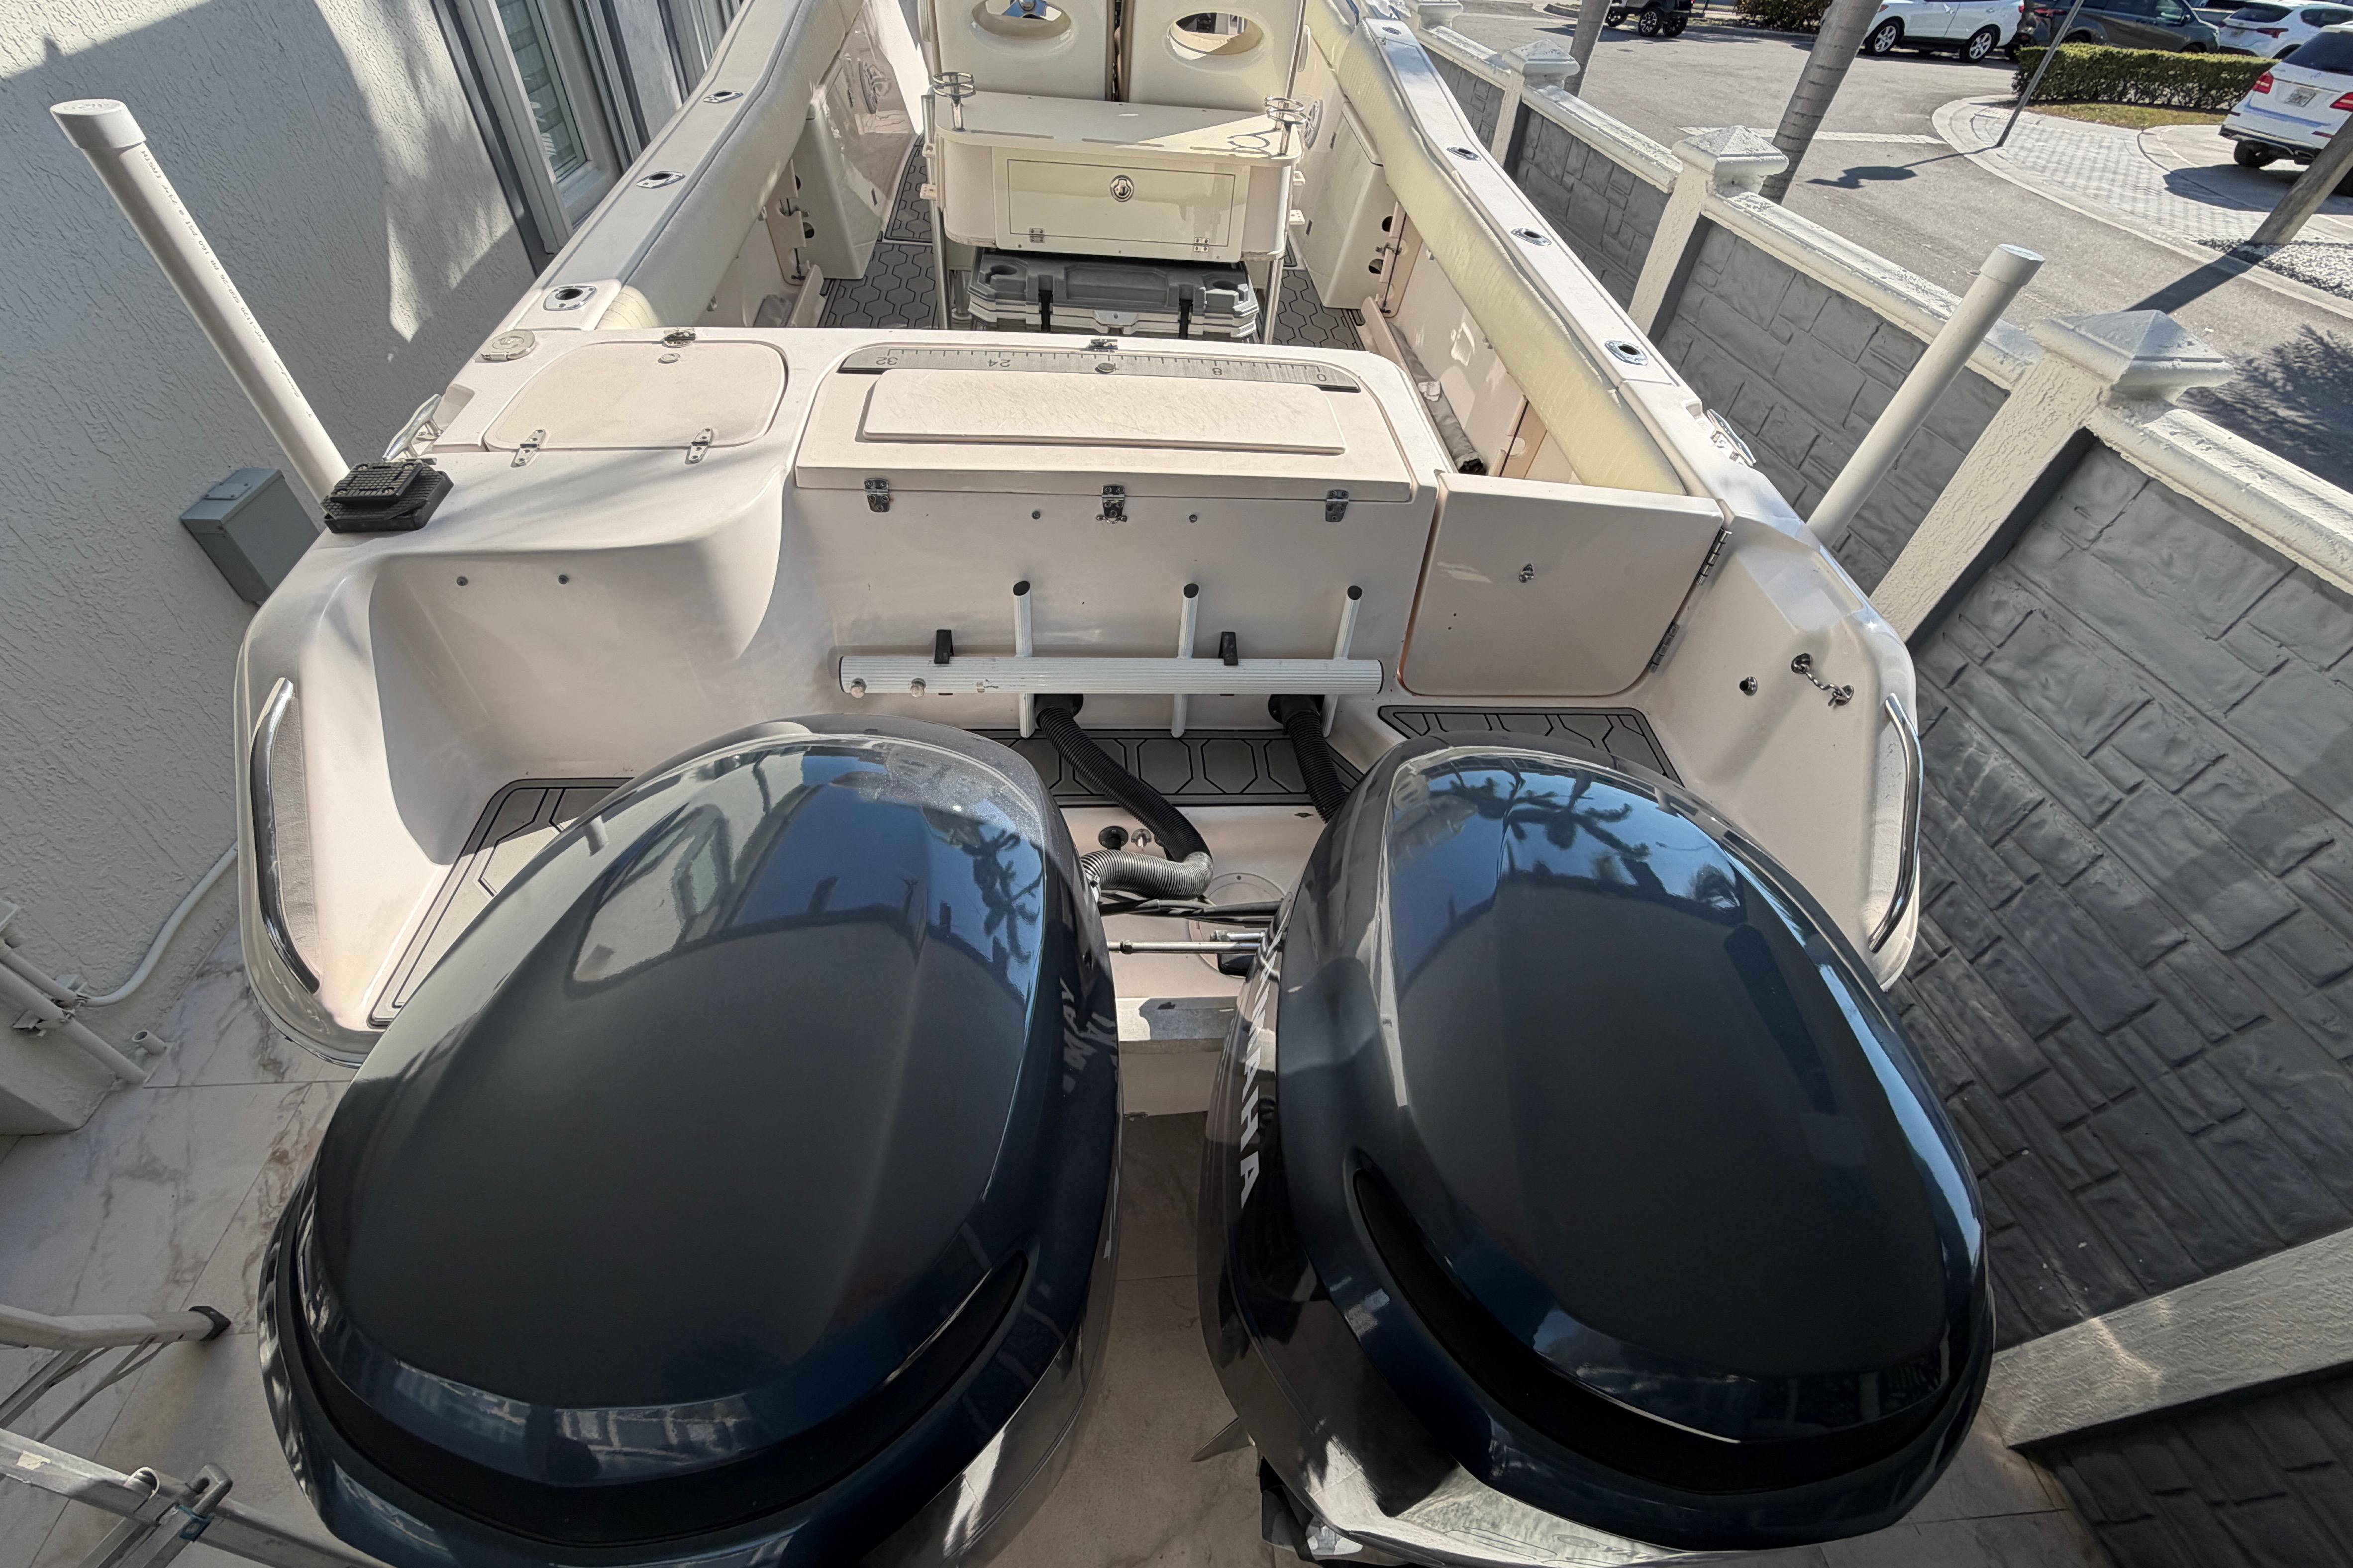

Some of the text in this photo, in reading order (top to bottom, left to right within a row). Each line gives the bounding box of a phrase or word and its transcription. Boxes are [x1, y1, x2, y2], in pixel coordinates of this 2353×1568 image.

[185, 221, 198, 236] PSI
[199, 240, 209, 254] 160
[220, 274, 239, 303] SDR-26
[876, 357, 898, 365] 32
[988, 359, 1011, 368] 24
[1212, 367, 1223, 376] 8
[1240, 907, 1290, 1209] YAMAHA
